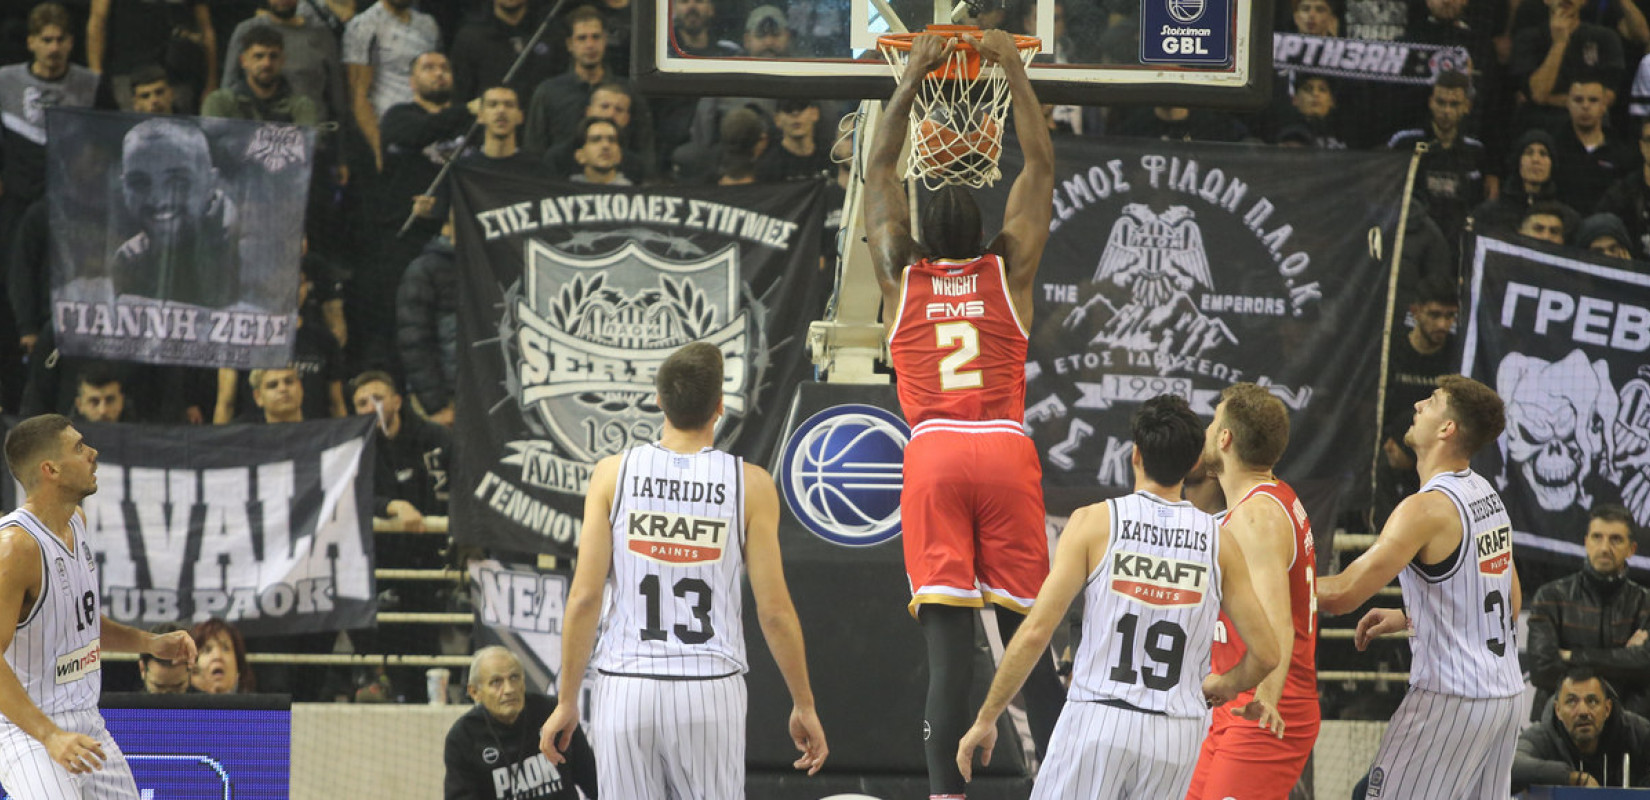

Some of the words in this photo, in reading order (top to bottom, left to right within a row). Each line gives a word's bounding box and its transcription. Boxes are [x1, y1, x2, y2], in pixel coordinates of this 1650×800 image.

[1160, 25, 1211, 36] Stoiximan
[1162, 37, 1208, 55] GBL
[478, 201, 540, 241] ΣΤΙΣ
[540, 193, 685, 226] ΔΥΣΚΟΛΕΣ
[688, 199, 799, 250] ΣΤΙΓΜΕΣ
[931, 274, 979, 297] WRIGHT
[1043, 284, 1079, 303] THE
[1201, 294, 1286, 316] EMPERORS
[55, 300, 199, 341] ΓΙΑΝΝΗ
[926, 300, 985, 320] FMS
[936, 321, 983, 392] 2
[1054, 350, 1113, 375] ΕΤΟΣ
[581, 417, 664, 456] 198
[632, 476, 726, 505] IATRIDIS
[15, 437, 372, 600] AVALA
[629, 512, 726, 543] KRAFT
[651, 545, 699, 559] PAINTS
[1121, 520, 1207, 551] KATSIVELIS
[1476, 527, 1510, 557] KRAFT
[1113, 553, 1206, 587] KRAFT
[191, 577, 334, 622] PAOK
[638, 574, 713, 645] 13
[1135, 586, 1180, 601] PAINTS
[75, 590, 94, 631] 18
[1484, 589, 1516, 657] 3
[1109, 613, 1187, 692] 19
[492, 752, 561, 799] PAOK
